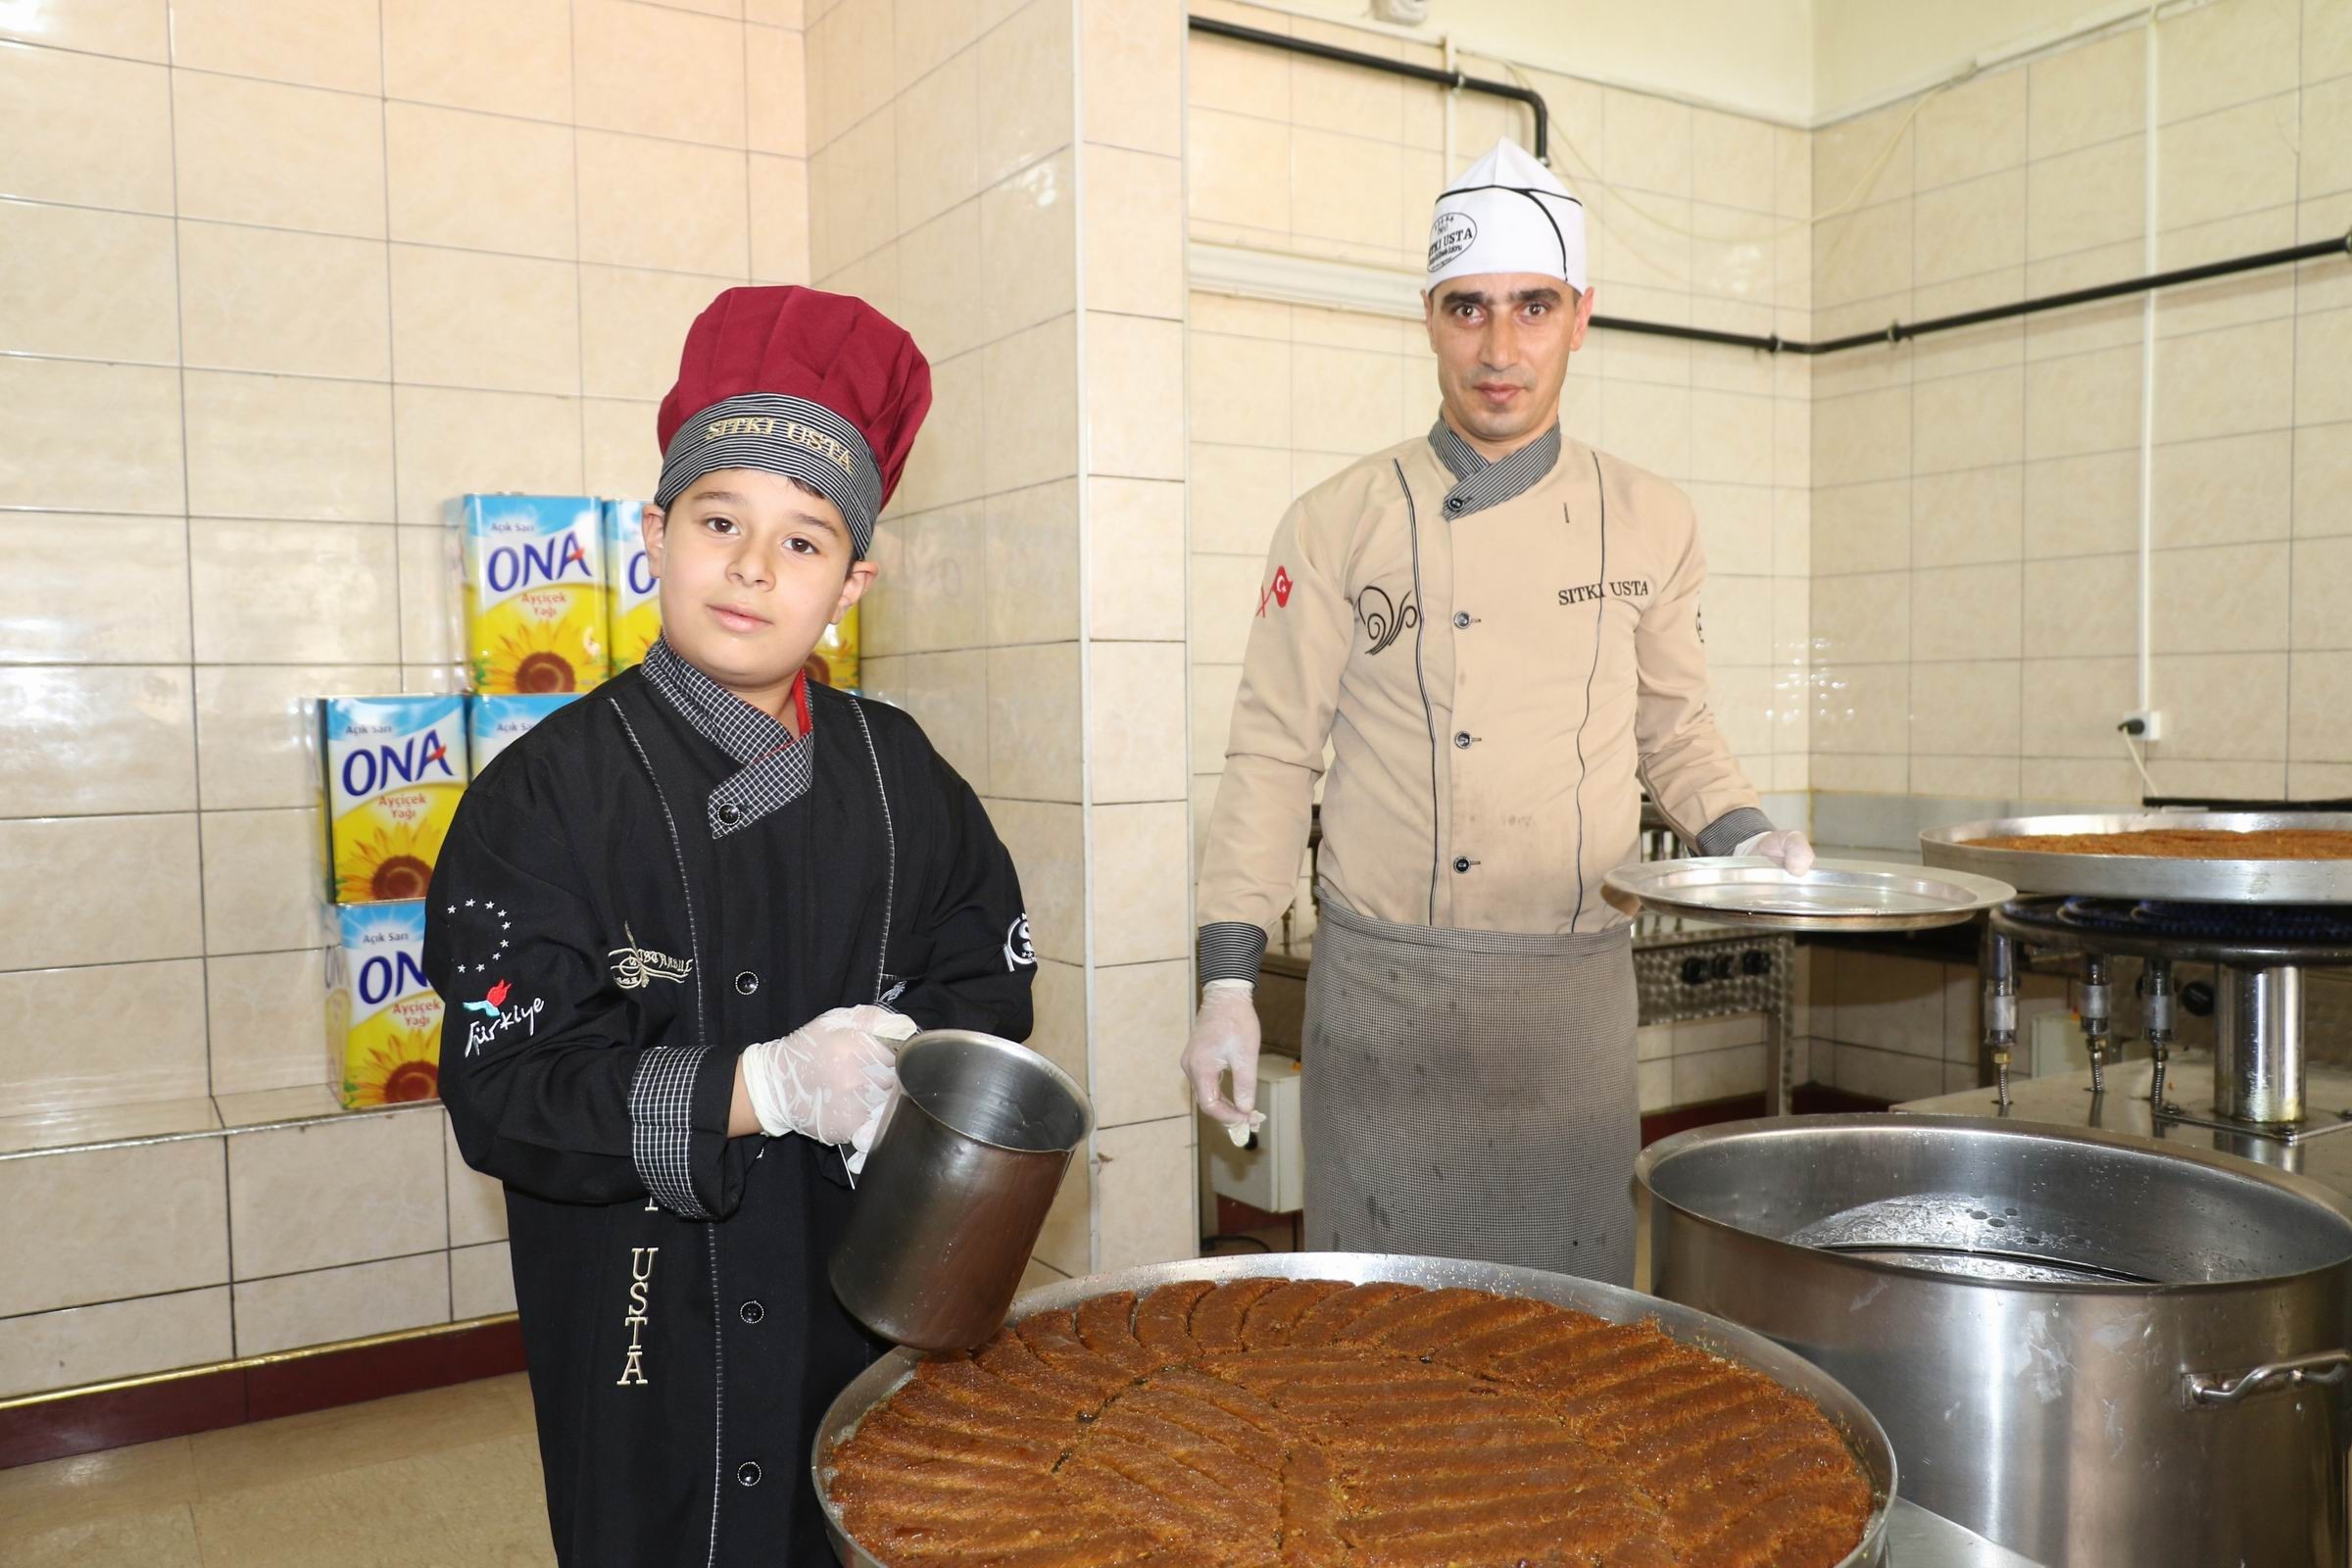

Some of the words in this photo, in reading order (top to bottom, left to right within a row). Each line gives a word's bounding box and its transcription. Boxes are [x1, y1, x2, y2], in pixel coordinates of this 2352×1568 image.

[1444, 227, 1473, 246] USTA
[706, 416, 777, 440] SITKI
[786, 421, 853, 471] USTA
[487, 530, 593, 593] ONA
[1558, 583, 1606, 607] SITKI
[1609, 580, 1649, 597] USTA
[342, 729, 455, 797] ONA
[363, 932, 385, 945] Açık
[359, 951, 428, 1004] ON
[392, 1000, 441, 1015] Ayçiçek
[465, 998, 544, 1057] Türkiye
[616, 1248, 660, 1386] USTA
